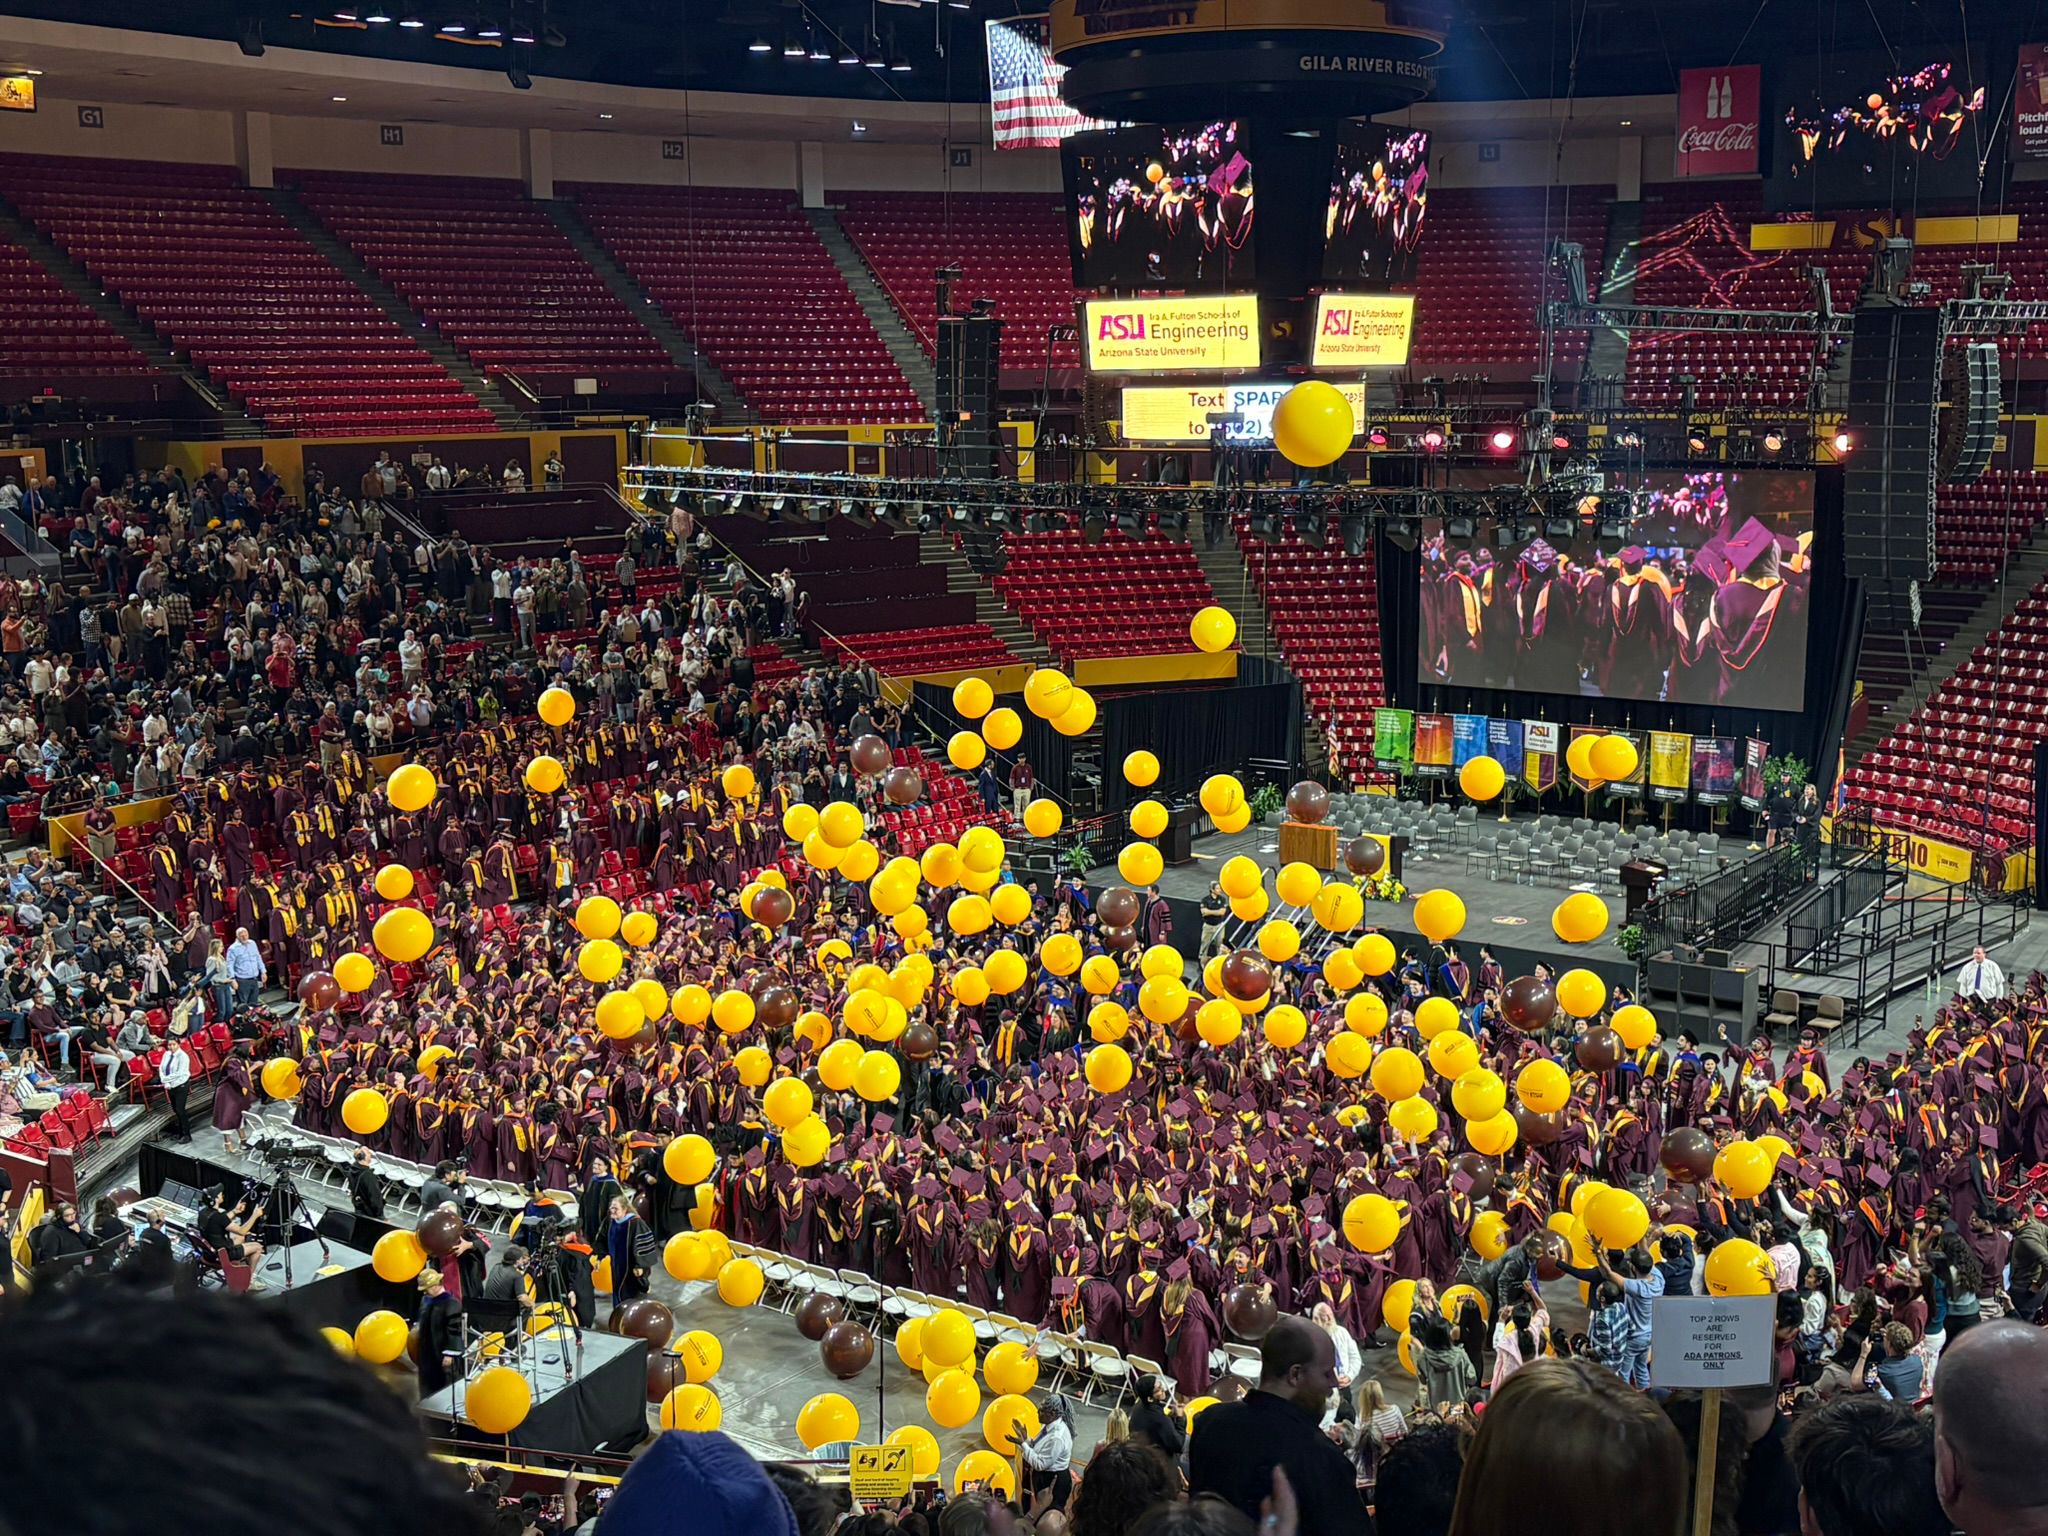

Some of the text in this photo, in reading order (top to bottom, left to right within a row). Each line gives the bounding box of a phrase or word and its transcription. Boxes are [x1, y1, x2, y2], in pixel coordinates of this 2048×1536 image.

[1299, 56, 1342, 71] GILA
[1347, 57, 1393, 74] RIVER
[82, 110, 101, 125] G1
[384, 128, 400, 142] H1
[2019, 125, 2043, 135] loud
[1679, 122, 1758, 154] Coca-Cola
[664, 143, 682, 157] H2
[1170, 312, 1196, 321] Fulton
[1198, 311, 1231, 320] Schools
[1232, 310, 1241, 319] of
[1322, 309, 1352, 336] ASU
[1099, 314, 1146, 340] ASU
[1151, 322, 1249, 343] Engineering
[1353, 320, 1405, 340] Engineering
[1099, 346, 1207, 358] Arizona State University
[1188, 391, 1224, 407] Text
[1189, 421, 1205, 435] to
[1529, 724, 1550, 738] ASU
[1690, 1314, 1740, 1323] TOP 2 ROWS
[1706, 1324, 1723, 1332] ARE
[1692, 1333, 1736, 1341] RESERVED
[1704, 1342, 1722, 1350] FOR
[1684, 1351, 1741, 1360] ADA PATRONS
[1703, 1361, 1725, 1370] ONLY
